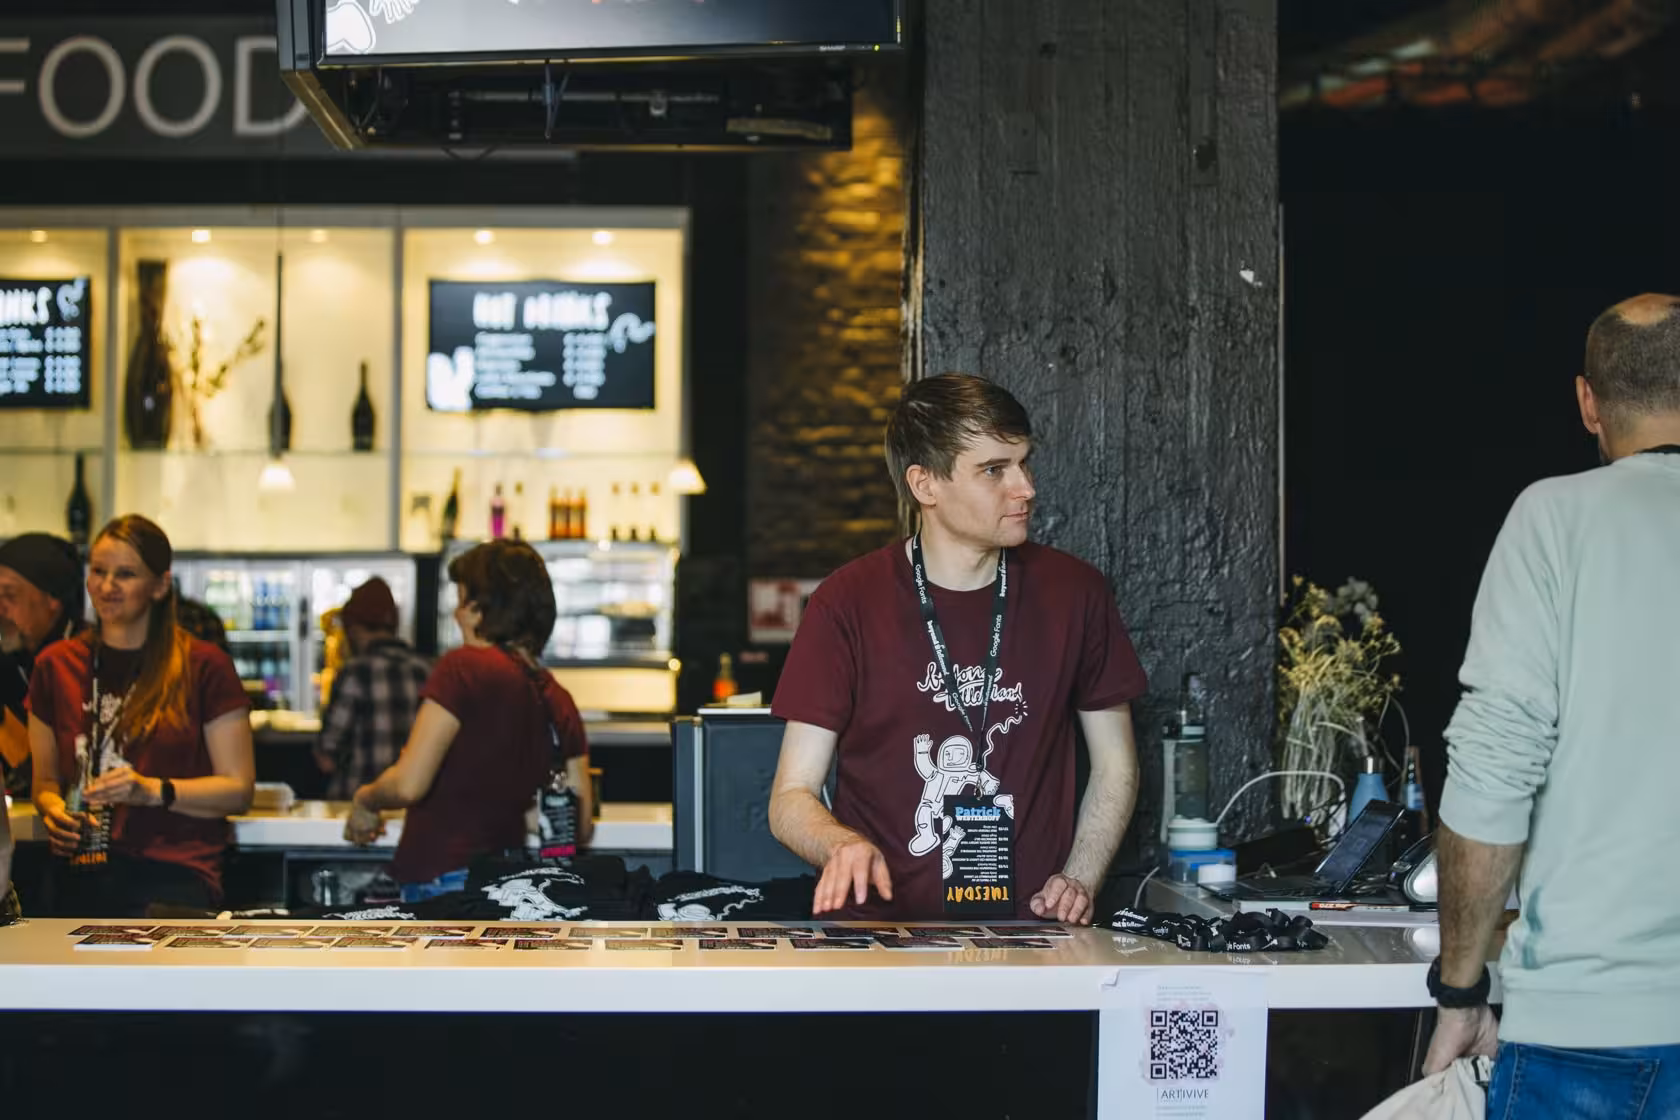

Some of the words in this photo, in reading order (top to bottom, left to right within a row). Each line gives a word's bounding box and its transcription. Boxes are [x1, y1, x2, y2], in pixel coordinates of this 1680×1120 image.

[914, 564, 923, 588] Google
[918, 586, 927, 605] Fonts
[993, 613, 1003, 634] Fonts
[989, 631, 1001, 658] Google
[955, 806, 1001, 816] Patrick
[947, 886, 1009, 902] TUESDAY
[1232, 942, 1251, 952] Fonts
